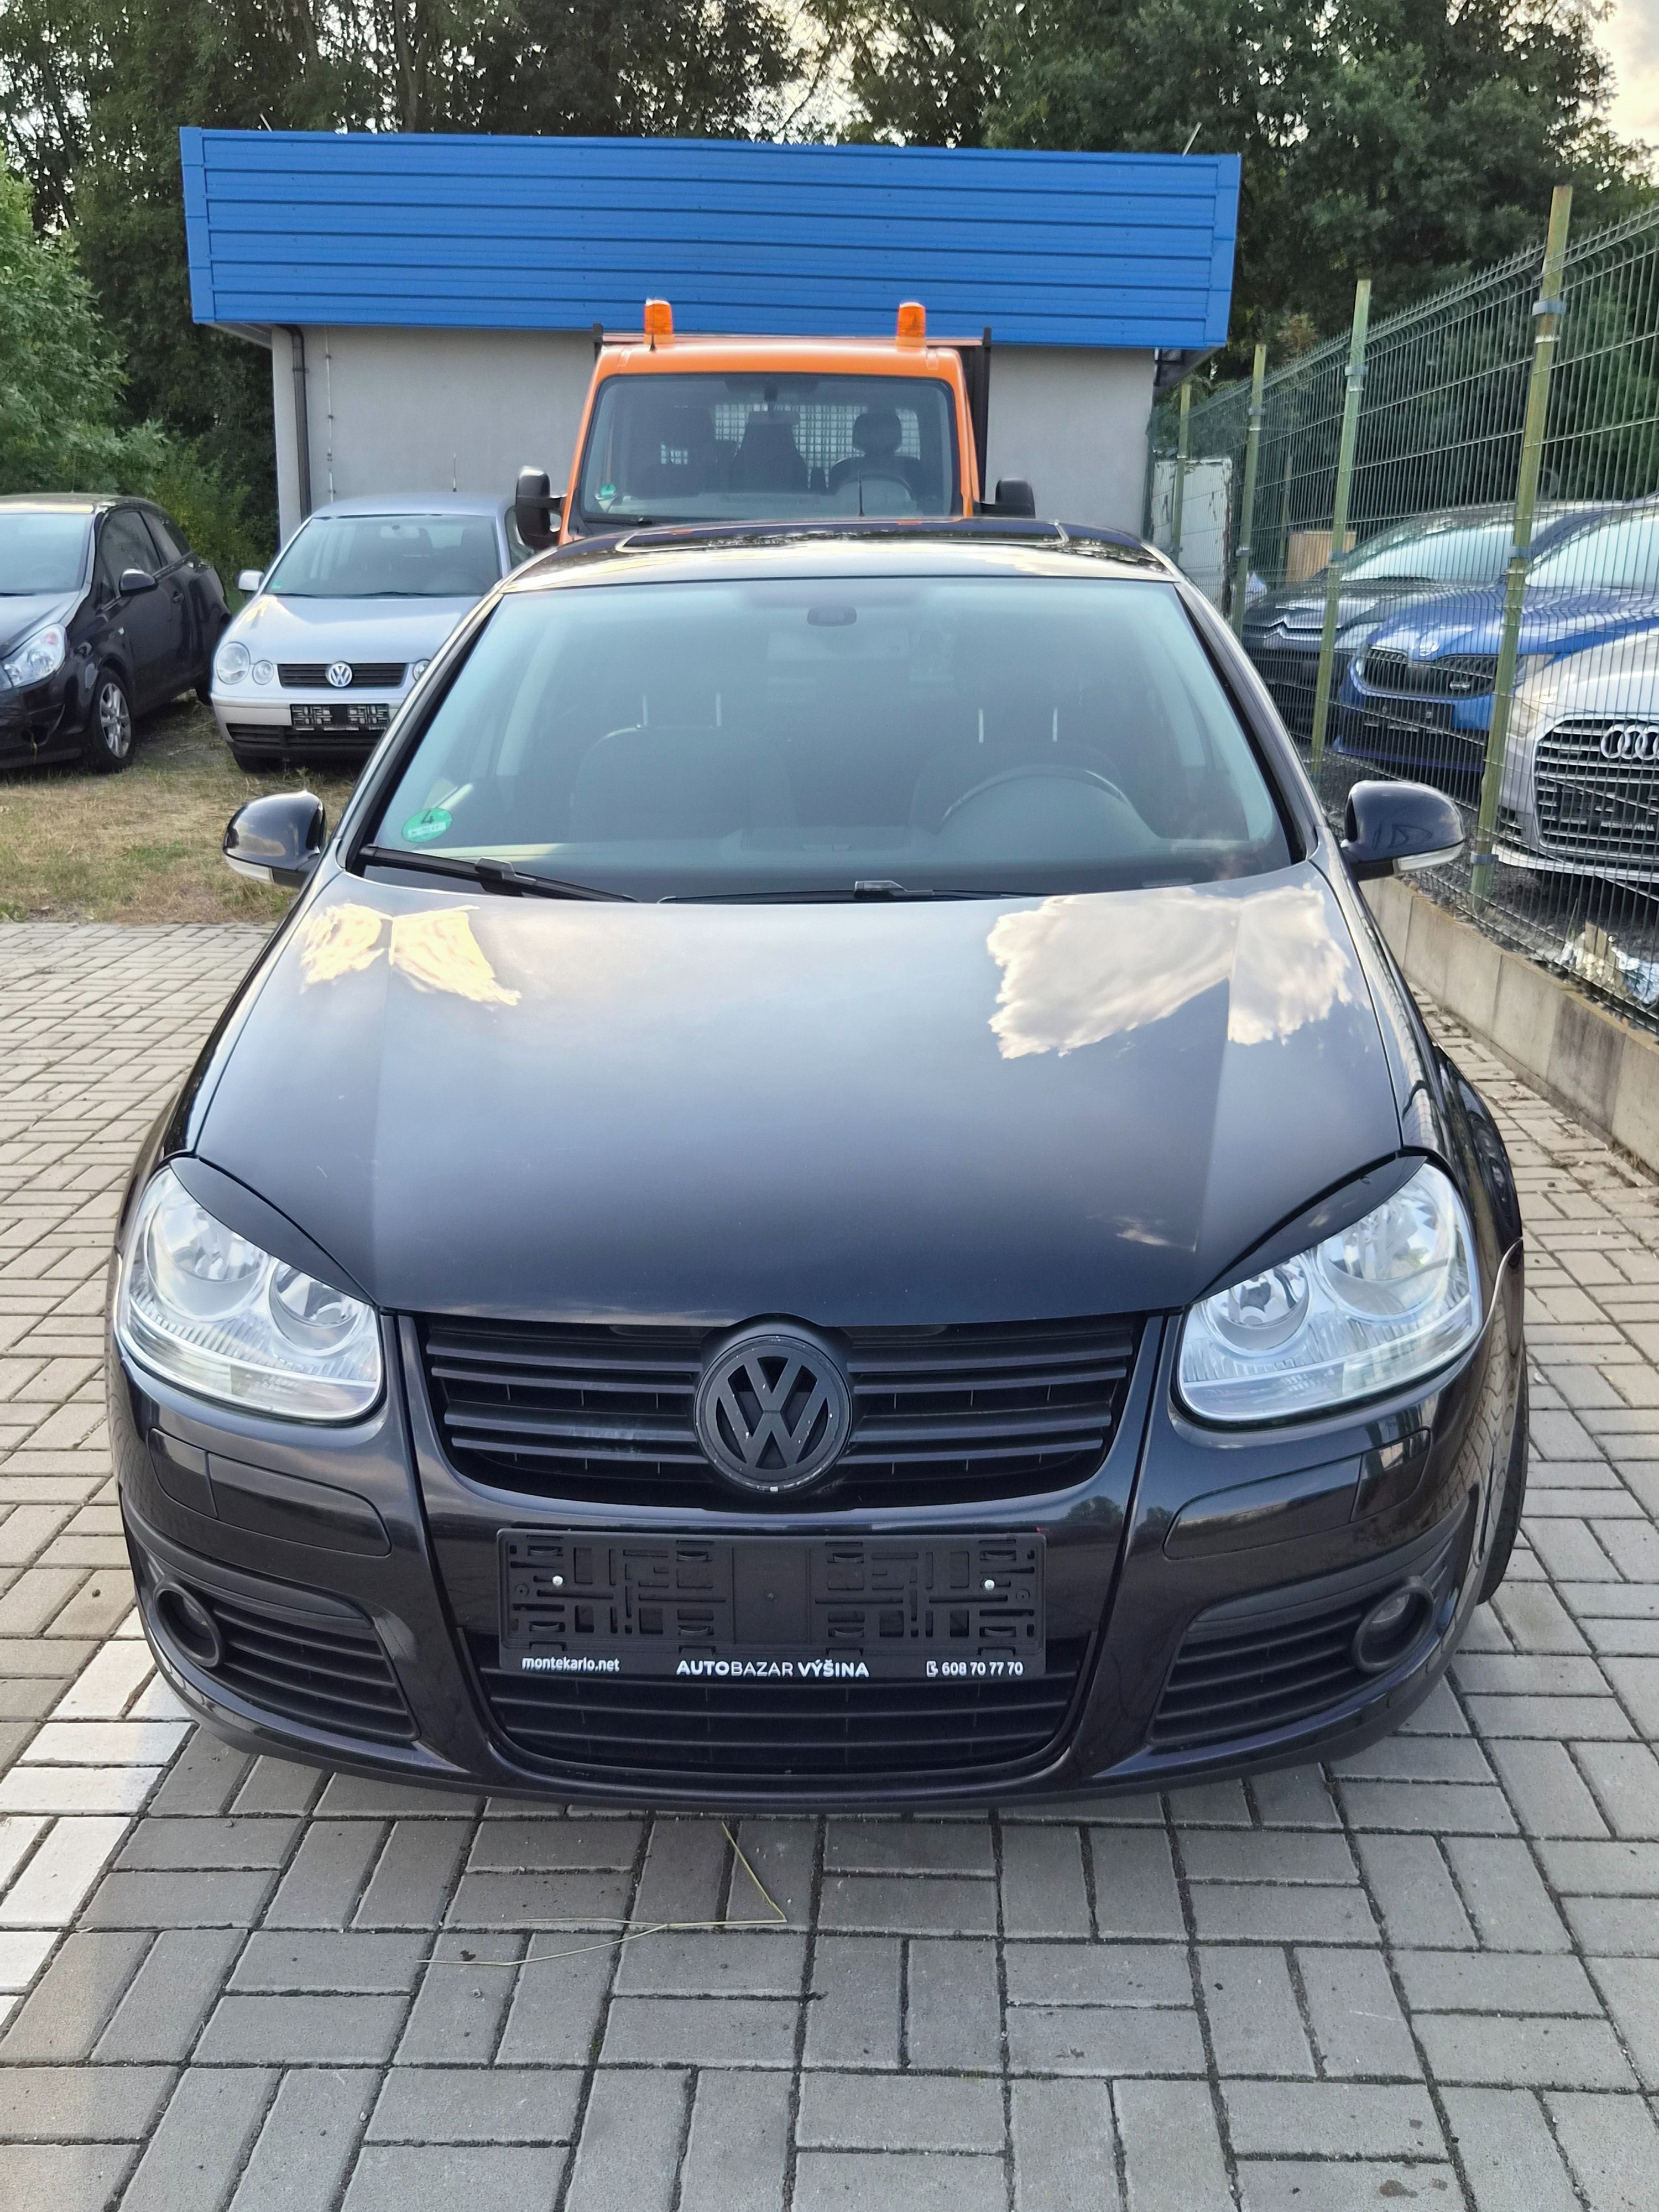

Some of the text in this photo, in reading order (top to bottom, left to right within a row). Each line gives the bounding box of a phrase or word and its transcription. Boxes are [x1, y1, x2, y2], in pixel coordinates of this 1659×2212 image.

[420, 810, 435, 824] 4
[521, 1656, 620, 1672] montekarlo.net
[676, 1658, 869, 1678] AUTOBAZAR VÝŠINA
[942, 1661, 1024, 1676] 608 70 77 70
